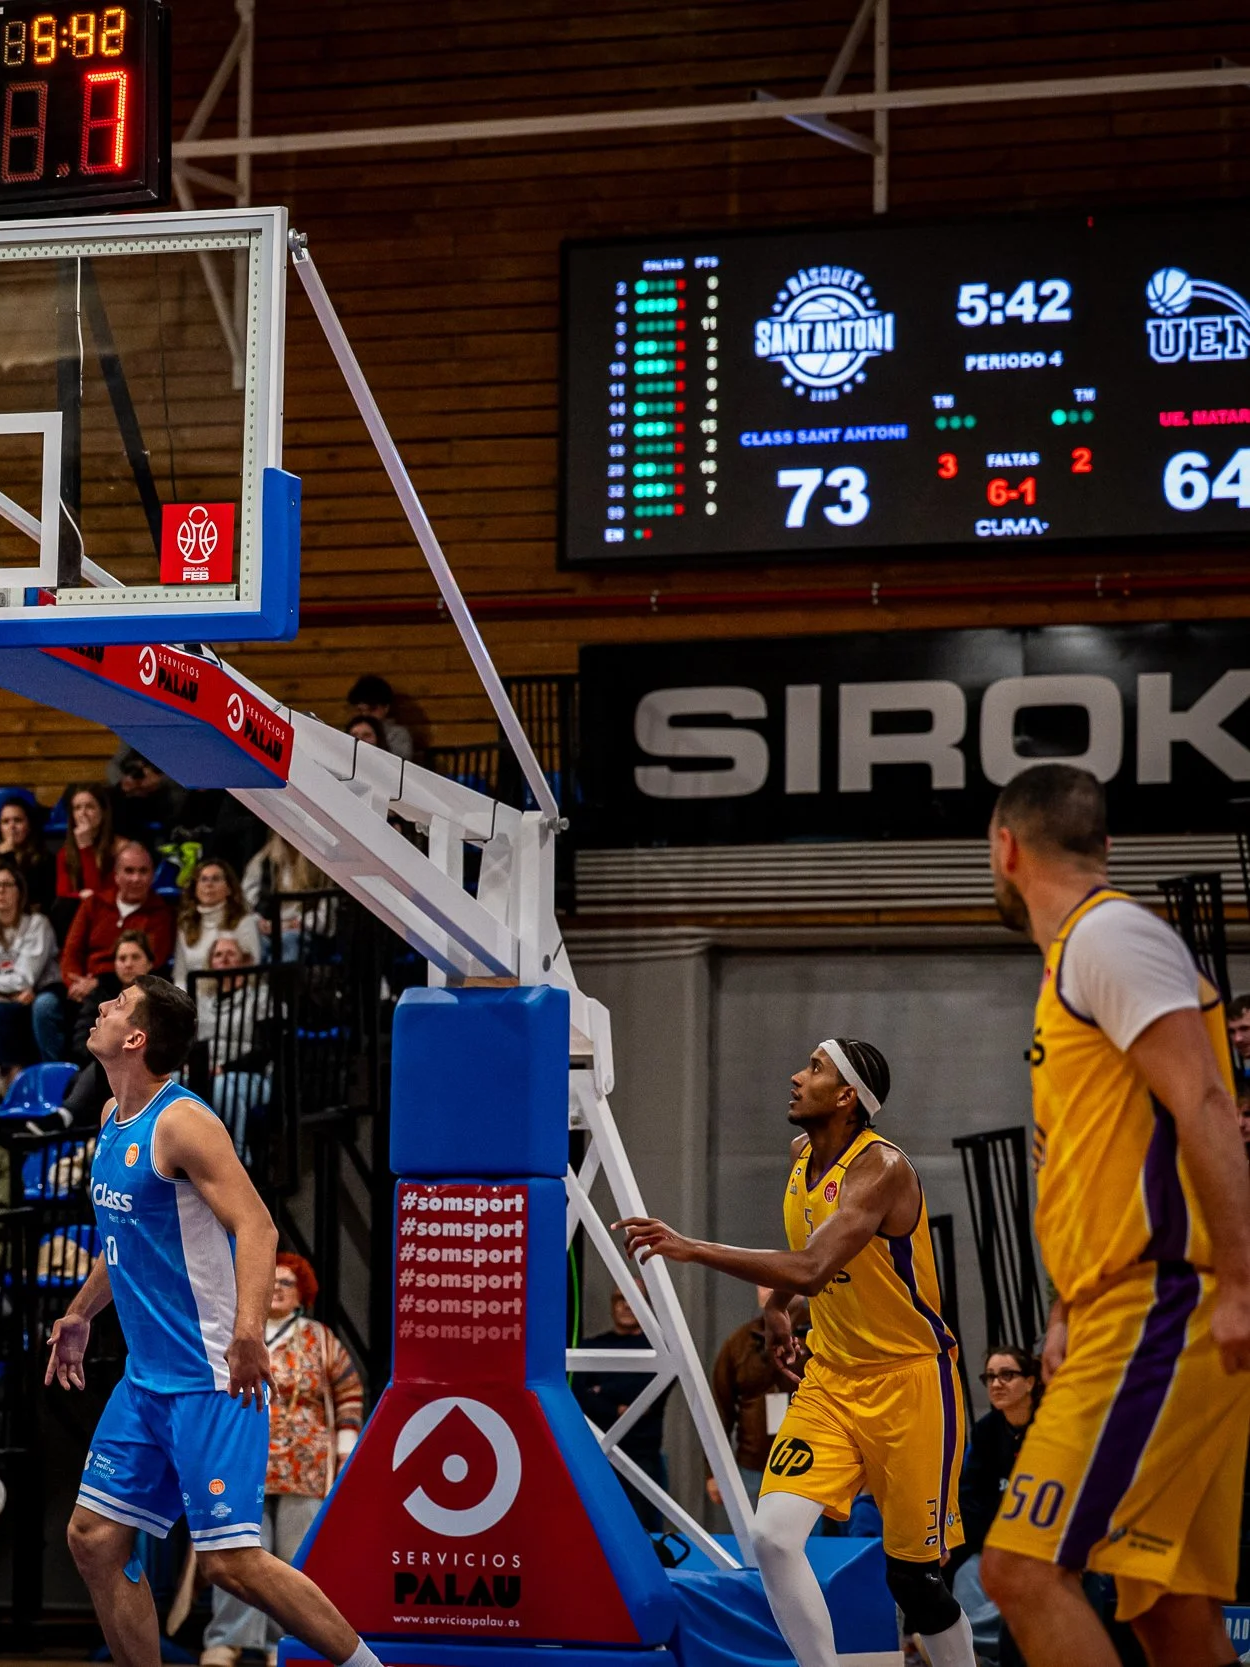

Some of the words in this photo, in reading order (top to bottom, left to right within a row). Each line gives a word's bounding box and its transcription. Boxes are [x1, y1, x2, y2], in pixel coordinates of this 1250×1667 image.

[786, 265, 865, 296] BASQUET
[957, 279, 1072, 326] 5:42
[965, 352, 1046, 371] PERIODO
[1049, 351, 1063, 367] 4
[933, 394, 954, 409] TM
[1074, 388, 1096, 402] TM
[740, 430, 794, 446] CLASS
[796, 427, 843, 444] SANT
[843, 424, 908, 441] ANTONI
[938, 453, 958, 479] 3
[986, 452, 1040, 468] FALTAS
[1071, 447, 1092, 473] 2
[986, 477, 1036, 507] 6-1
[1163, 448, 1250, 511] 64
[777, 466, 870, 528] 73
[183, 571, 209, 581] FEB
[158, 652, 199, 678] SERVICIOS
[158, 667, 198, 703] PALAU
[246, 704, 285, 741] SERVICIOS
[634, 669, 1250, 799] SIROK
[244, 720, 283, 763] PALAU
[93, 1182, 132, 1212] Class
[402, 1191, 524, 1216] #somsport
[400, 1217, 524, 1242] #somsport
[399, 1243, 523, 1268] #somsport
[399, 1268, 522, 1293] #somsport
[399, 1294, 522, 1318] #somsport
[399, 1320, 521, 1344] #somsport
[770, 1437, 812, 1477] hp
[1001, 1473, 1065, 1528] 50
[392, 1551, 521, 1569] SERVICIOS
[394, 1572, 522, 1608] PALAU
[393, 1615, 520, 1628] www.serviciospalau.es
